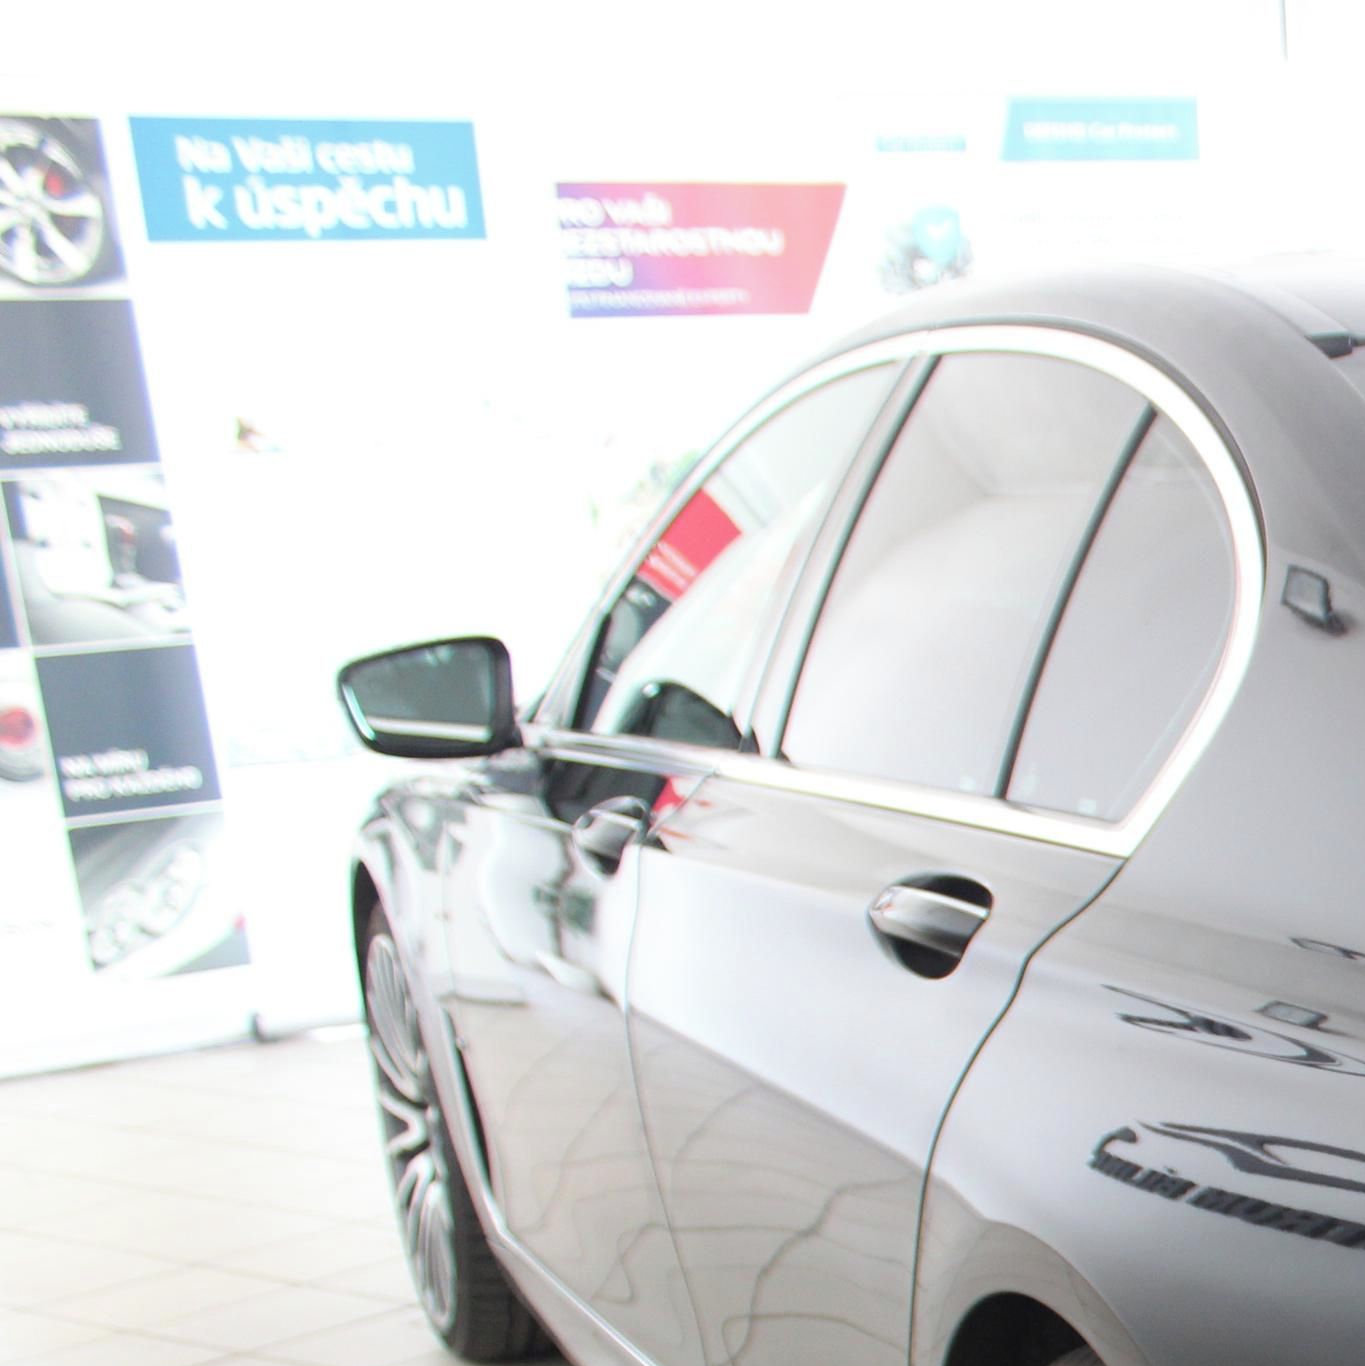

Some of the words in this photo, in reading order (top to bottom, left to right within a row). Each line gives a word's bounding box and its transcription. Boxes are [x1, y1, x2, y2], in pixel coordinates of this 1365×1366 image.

[176, 135, 231, 173] Na
[316, 138, 416, 174] cestu
[183, 174, 228, 230] k
[233, 174, 468, 239] úspěchu
